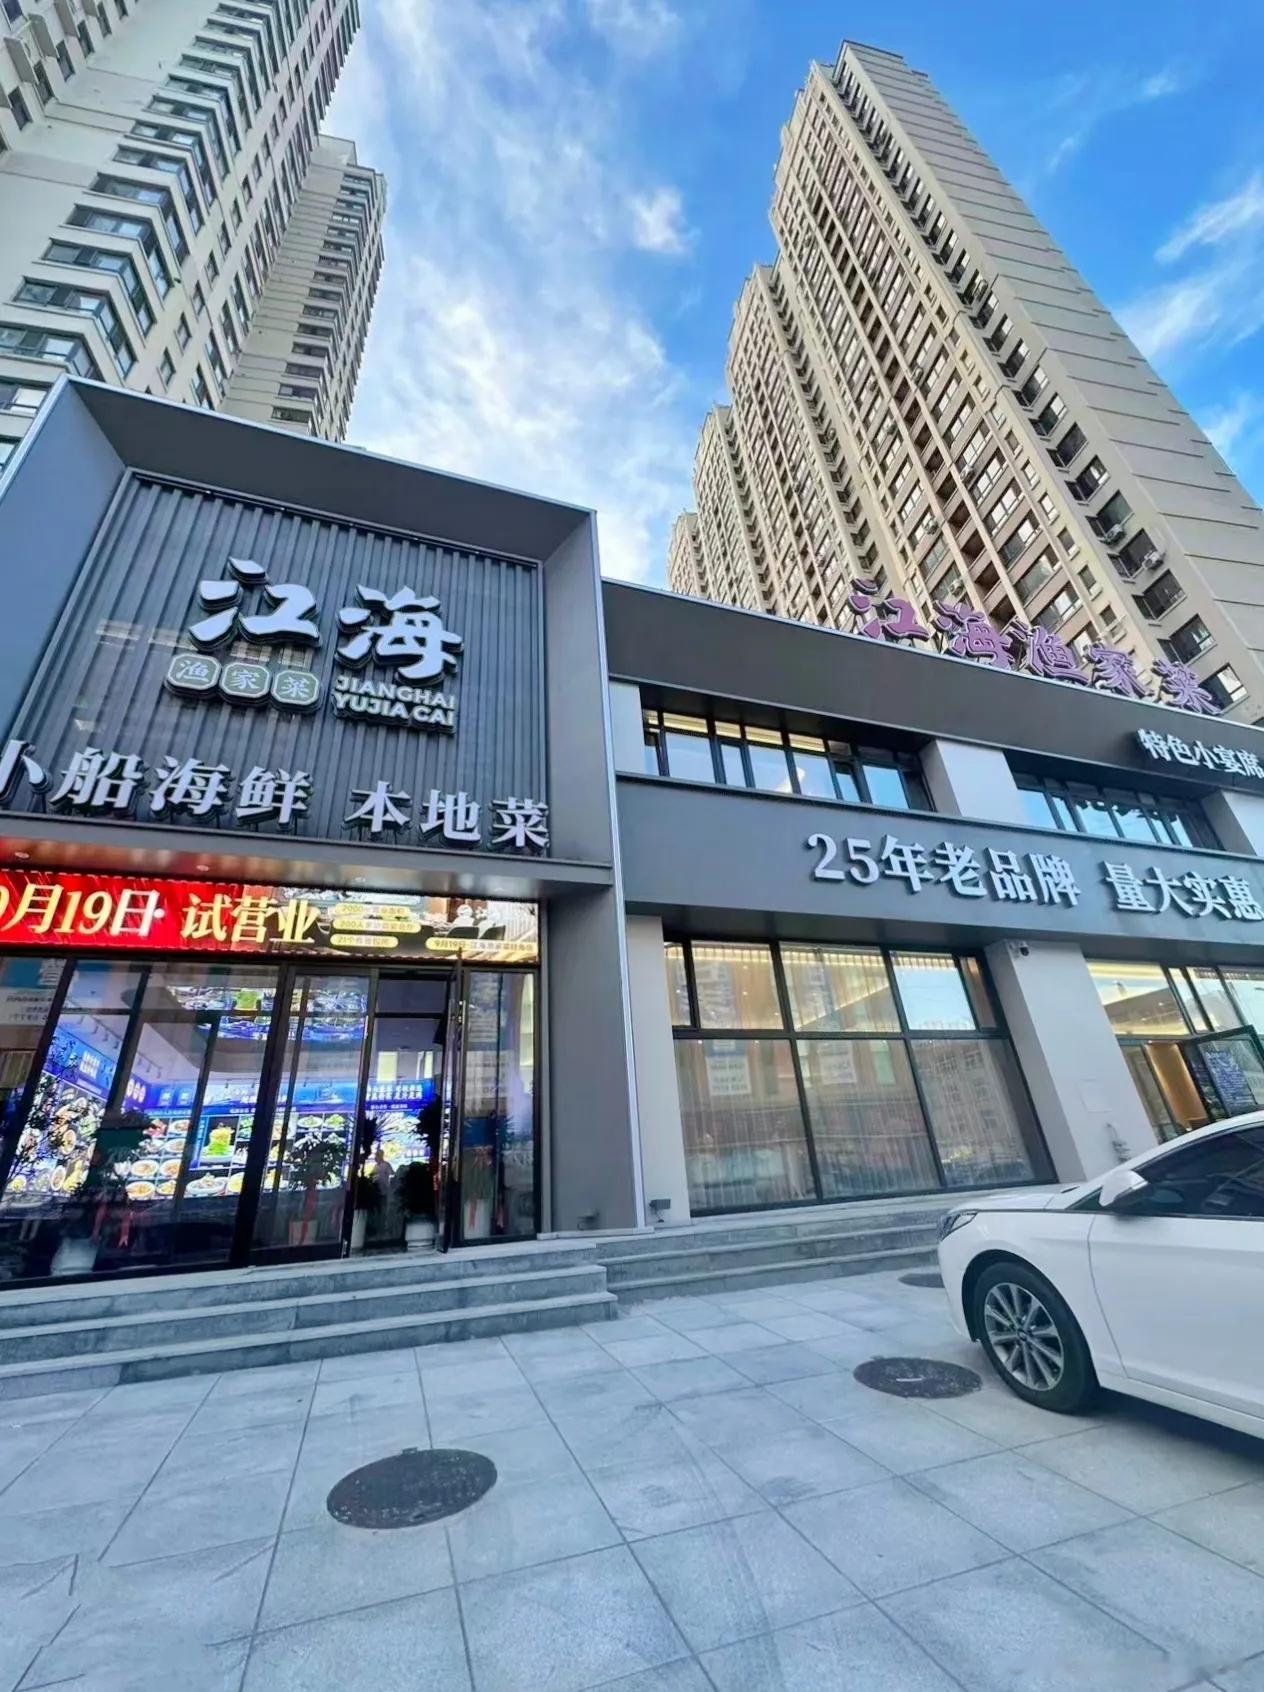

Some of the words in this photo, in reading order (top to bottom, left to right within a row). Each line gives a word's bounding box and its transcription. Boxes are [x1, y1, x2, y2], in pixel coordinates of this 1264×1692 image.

[189, 556, 465, 684] 江海
[849, 579, 1223, 716] 江海渔家菜
[177, 656, 317, 704] 渔家菜
[335, 676, 455, 709] JIANGHAI
[333, 693, 411, 721] YUJIA
[412, 704, 456, 727] CAI
[1138, 728, 1264, 779] 特色小宴席
[344, 780, 551, 849] 本地菜
[807, 833, 1082, 907] 25年老品牌
[1103, 860, 1264, 921] 量大实惠
[180, 893, 320, 945] 试营业
